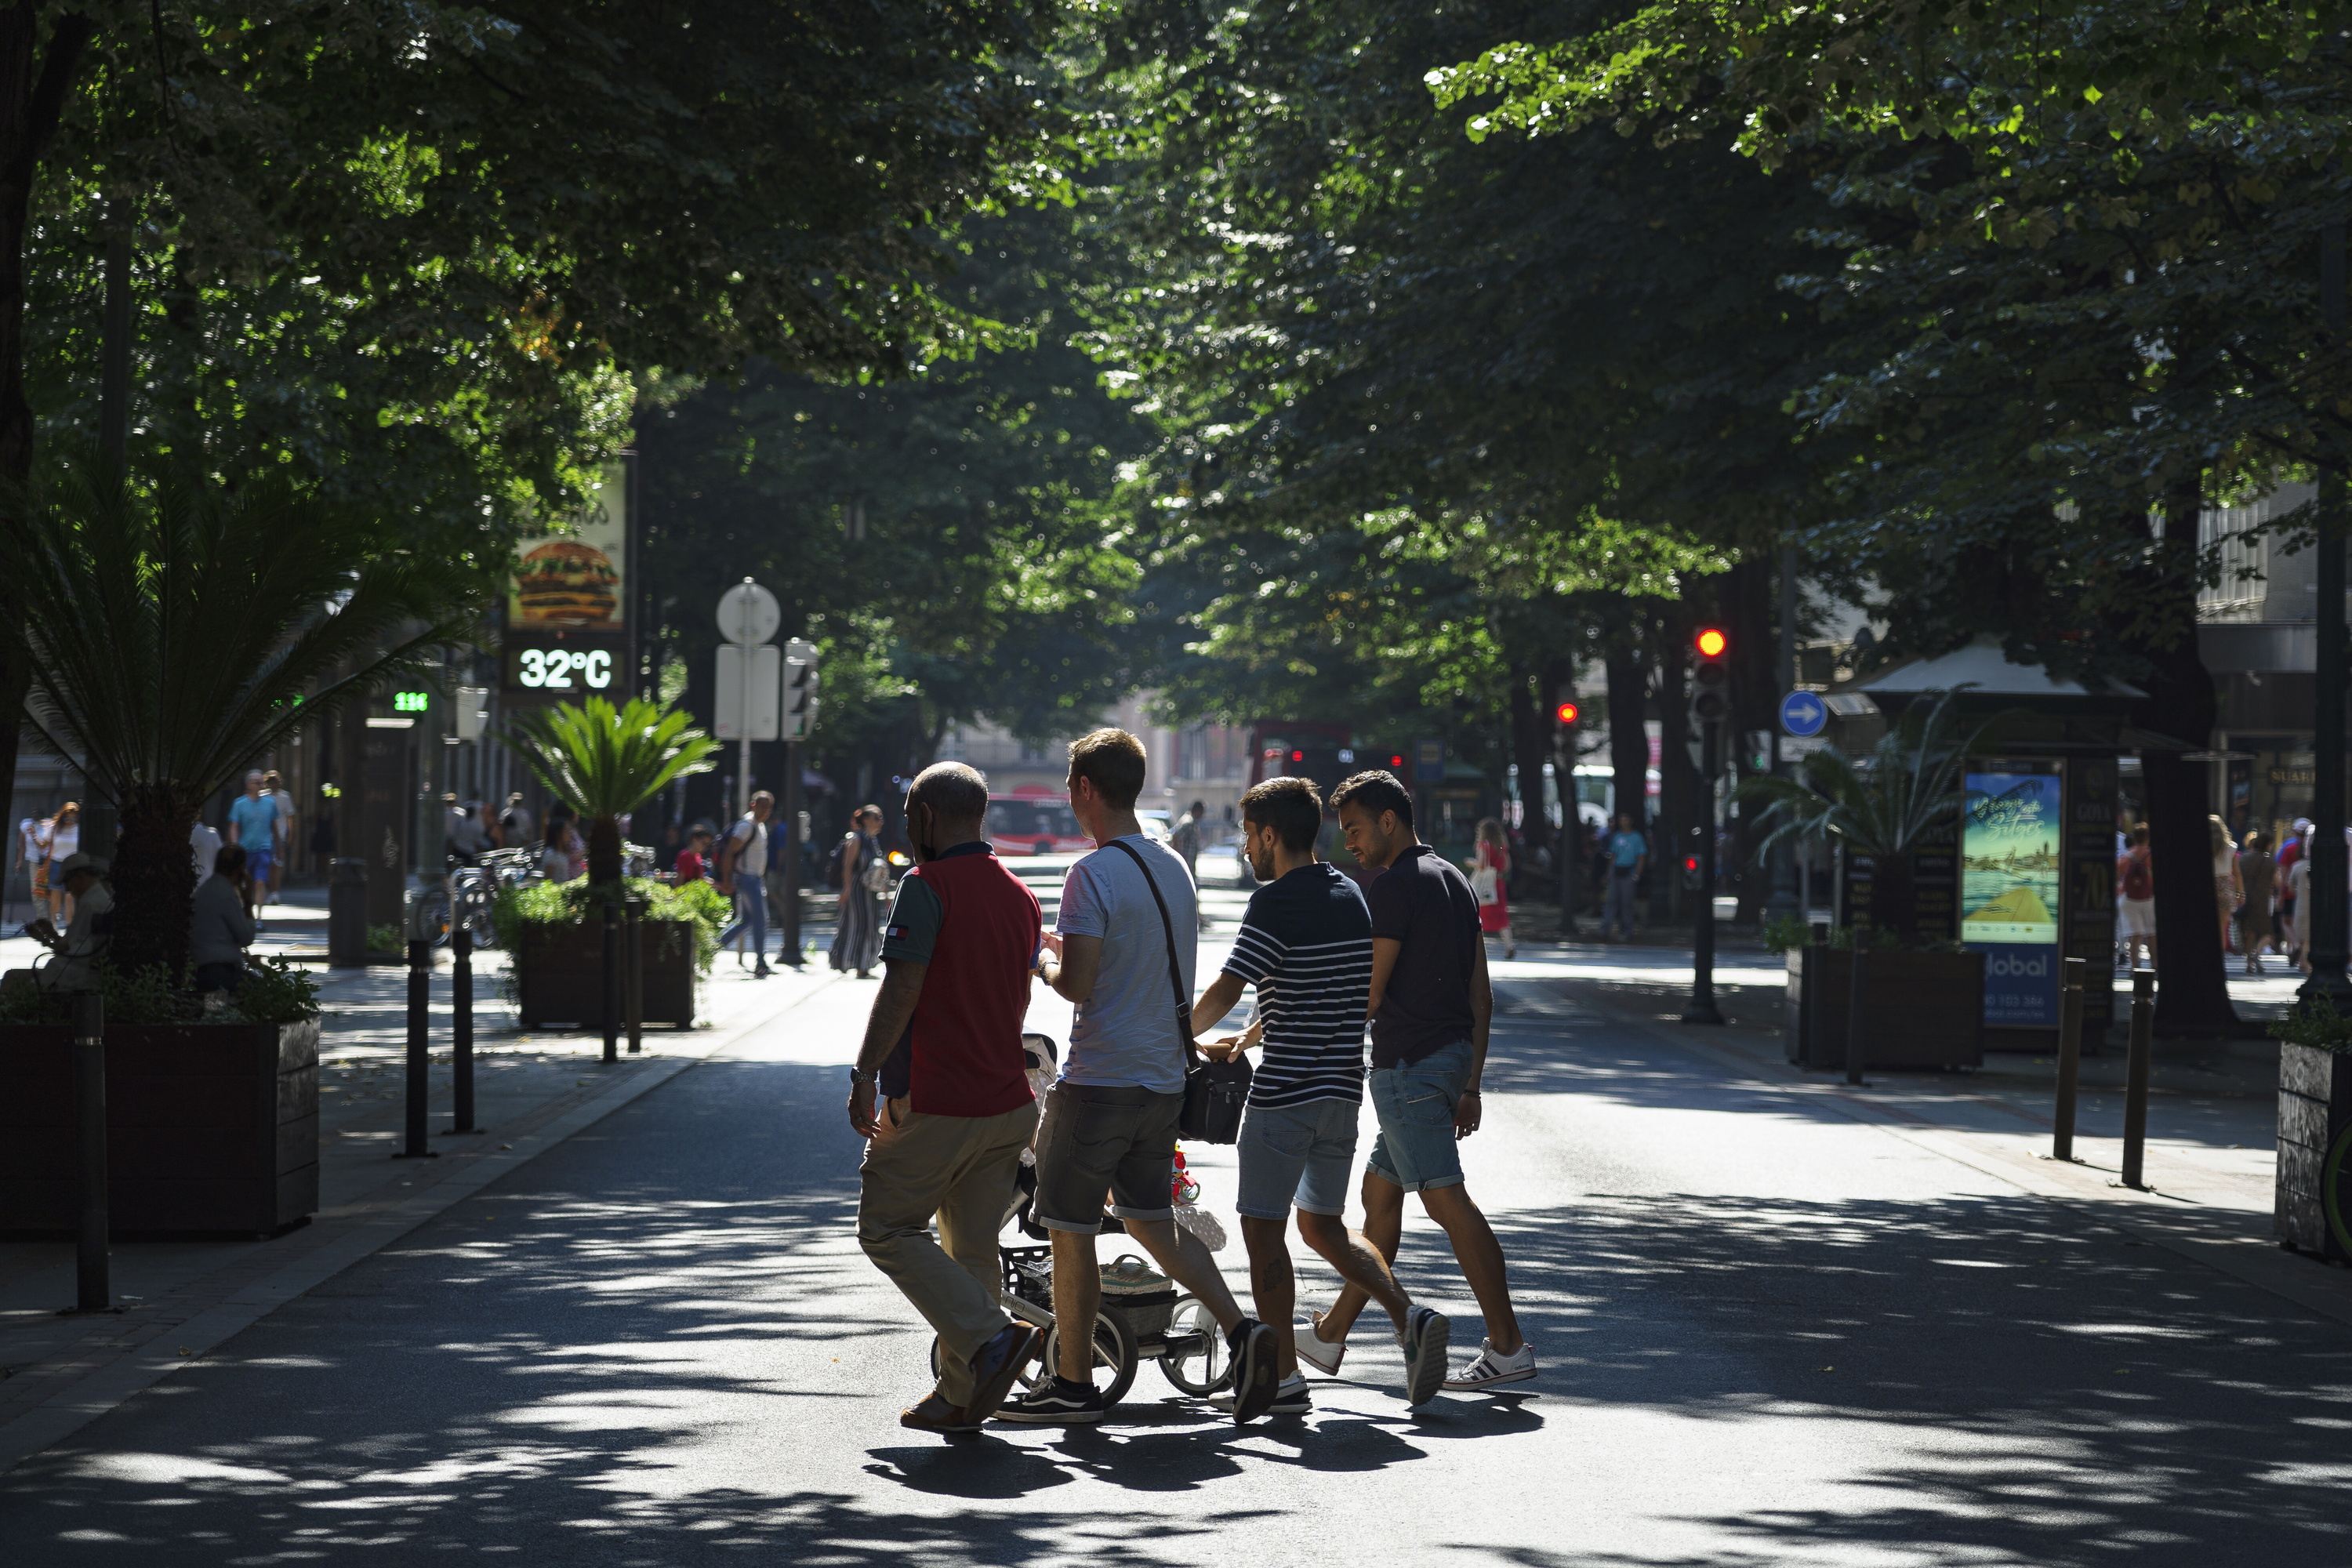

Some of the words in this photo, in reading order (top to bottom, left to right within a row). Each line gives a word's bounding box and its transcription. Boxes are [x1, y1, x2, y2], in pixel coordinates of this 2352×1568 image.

[520, 649, 611, 688] 32°C
[1984, 811, 2045, 841] Sitges
[1984, 952, 2048, 980] lobal
